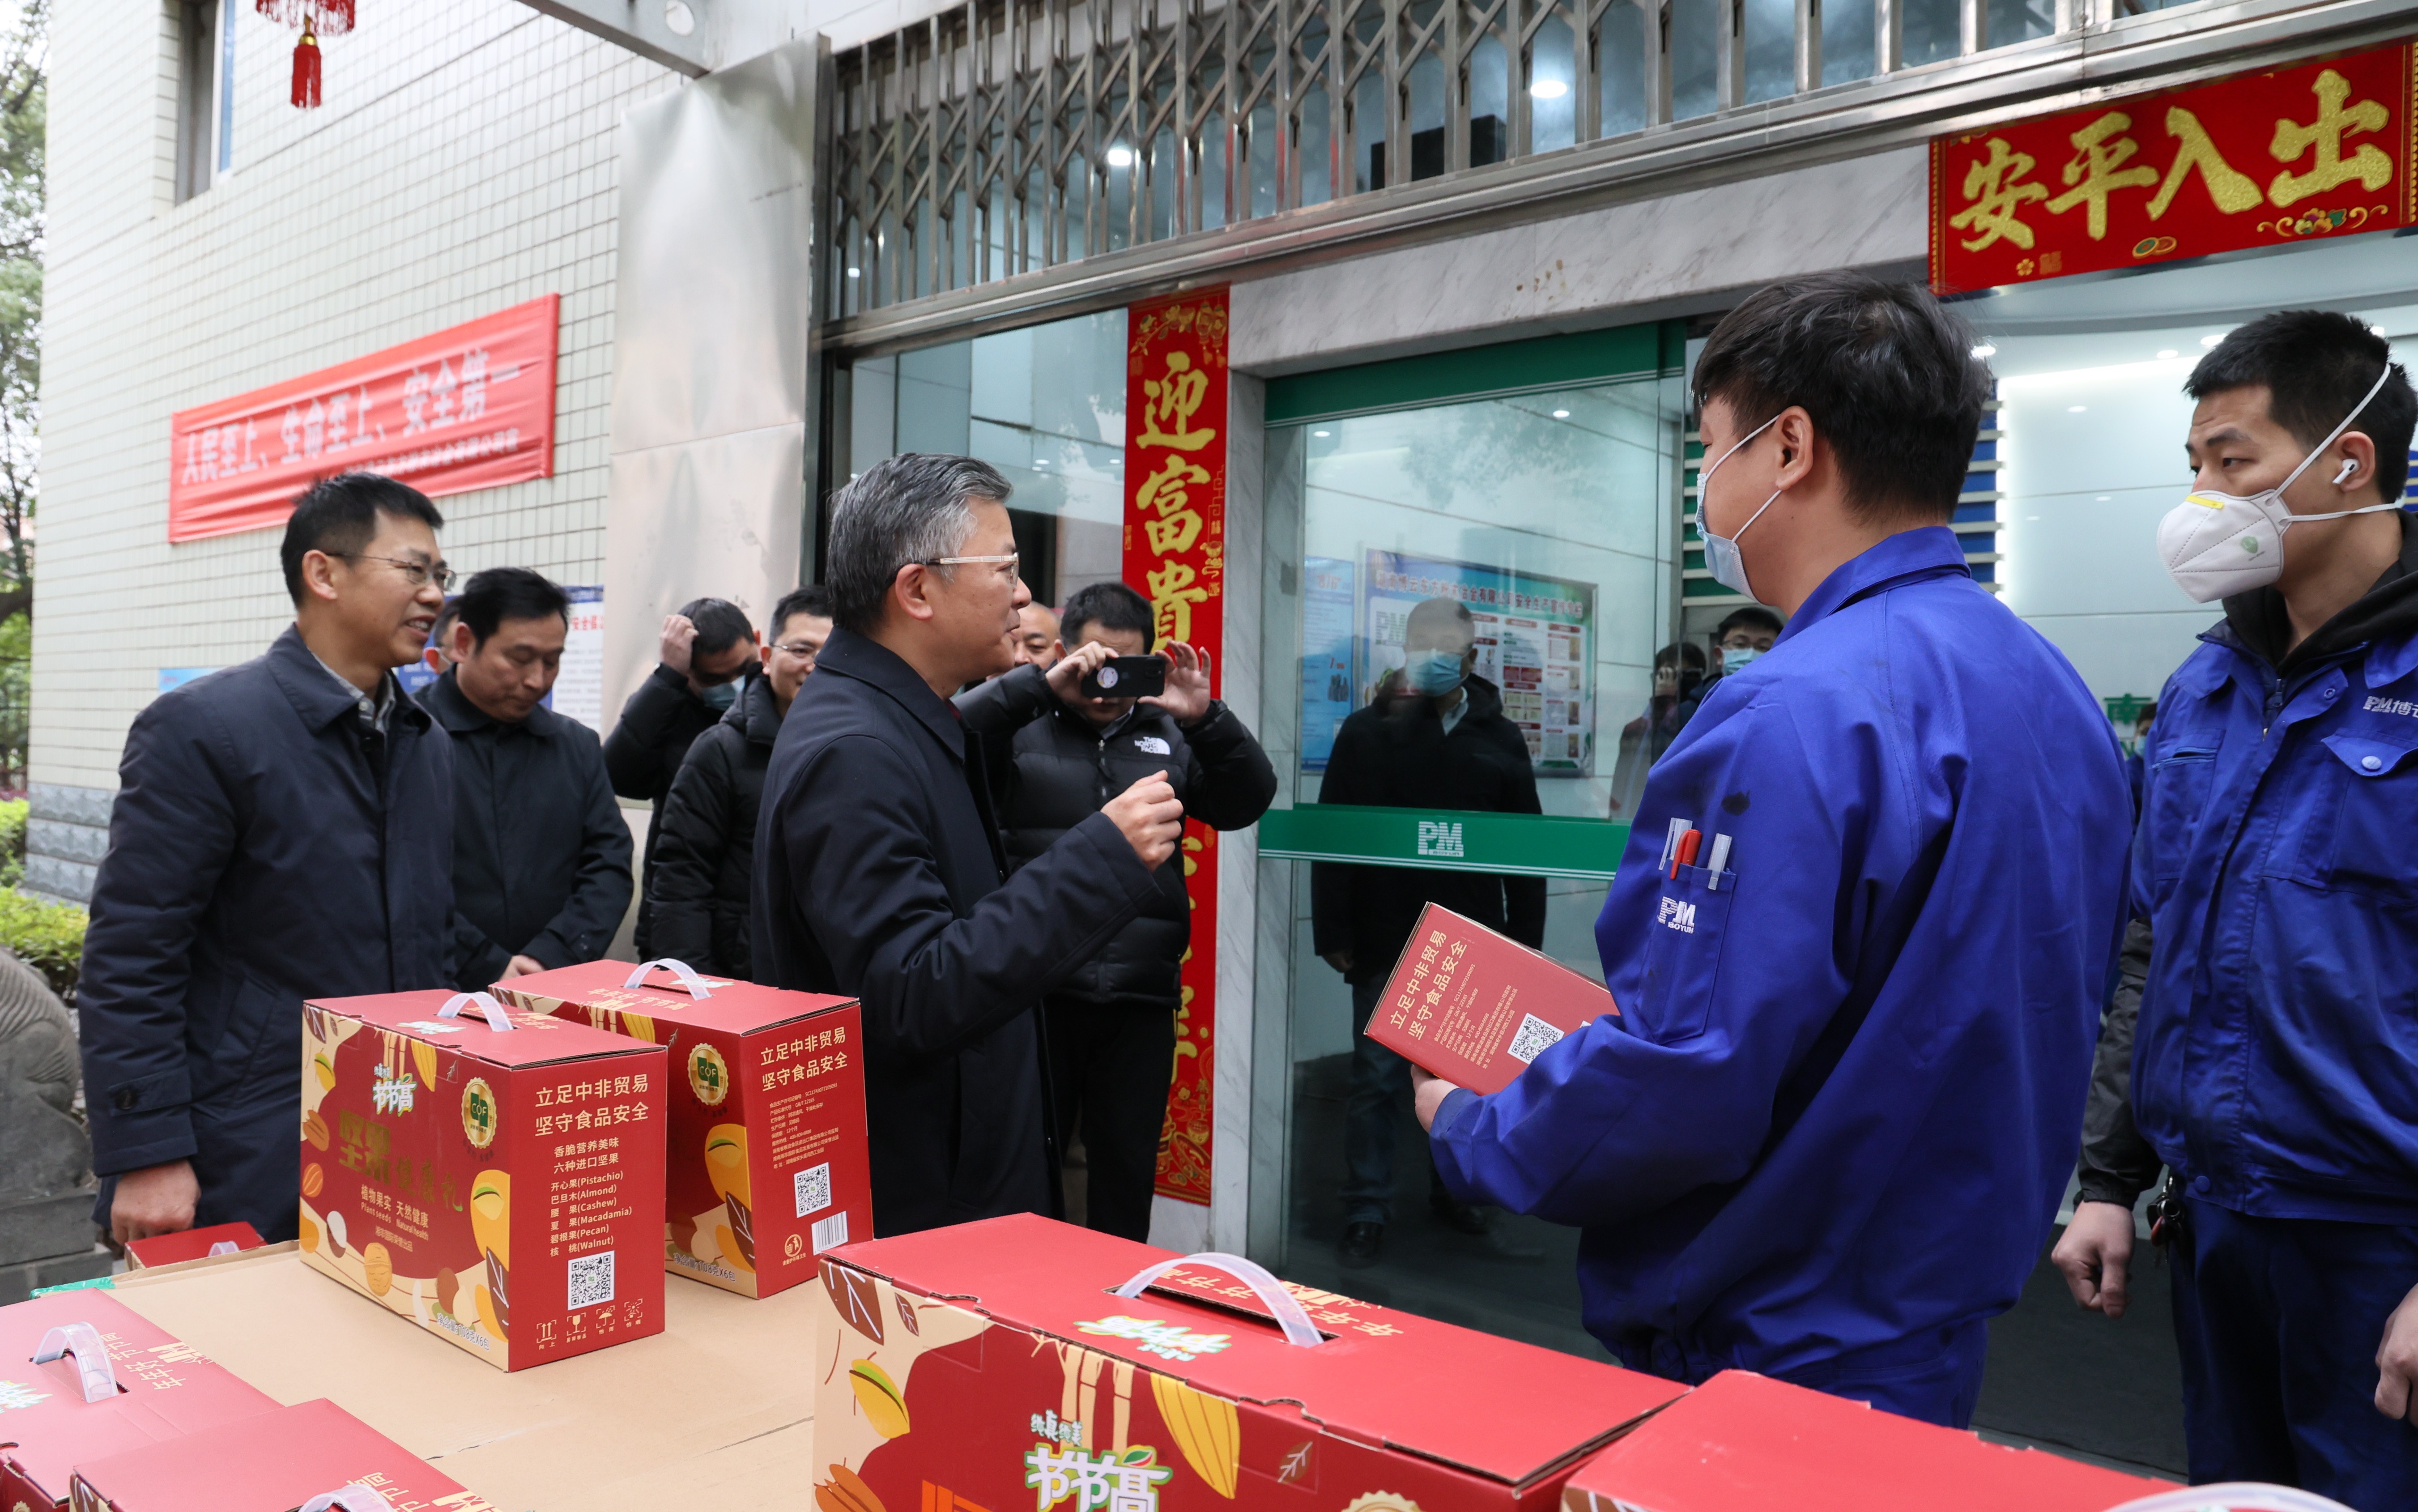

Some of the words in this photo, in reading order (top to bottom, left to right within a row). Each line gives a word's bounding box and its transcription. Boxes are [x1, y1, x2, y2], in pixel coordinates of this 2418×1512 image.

[1418, 821, 1464, 855] PM
[1658, 896, 1696, 927] PM
[1668, 921, 1694, 934] BOYUN
[1390, 930, 1447, 1029] 立足中非贸易
[1408, 941, 1467, 1040] 坚守食品安全
[761, 1026, 846, 1066] 立足中非贸易
[762, 1052, 847, 1092] 坚守食品安全
[535, 1074, 648, 1107] 立足中非贸易
[535, 1102, 649, 1136] 坚守食品安全
[554, 1137, 619, 1158] 香脆营养美味
[554, 1153, 619, 1174] 六种进口坚果
[361, 1184, 392, 1211] 植物果实
[396, 1201, 429, 1228] 天然健康
